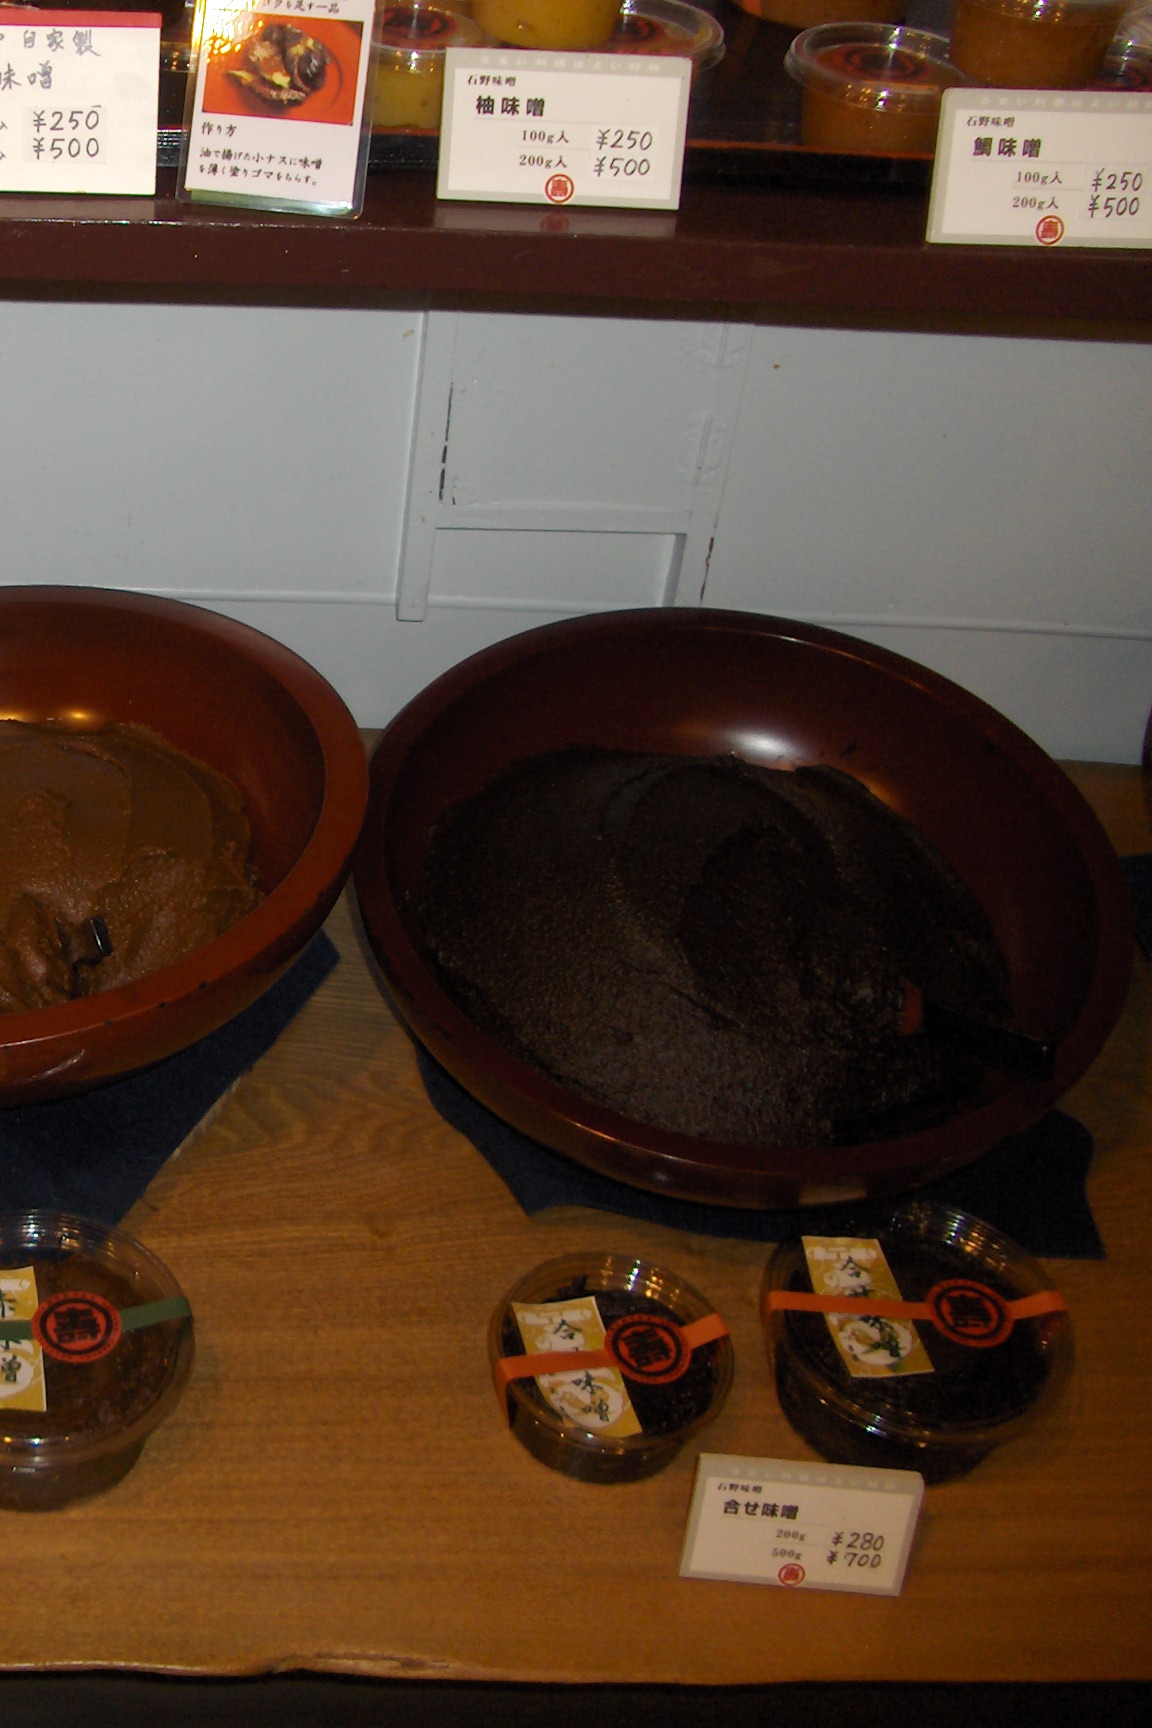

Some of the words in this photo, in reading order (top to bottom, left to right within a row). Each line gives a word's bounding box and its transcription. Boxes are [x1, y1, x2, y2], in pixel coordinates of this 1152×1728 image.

[23, 28, 102, 57] 自家製
[33, 107, 102, 132] ¥250
[201, 121, 237, 138] 作り方
[33, 137, 100, 161] ¥500
[596, 128, 653, 151] ¥250
[593, 156, 651, 177] ¥500
[1091, 168, 1143, 192] ¥250
[1088, 194, 1140, 218] ¥500
[723, 1499, 799, 1520] 合せ味噌
[831, 1531, 885, 1552] ¥280
[826, 1550, 882, 1569] ¥700
